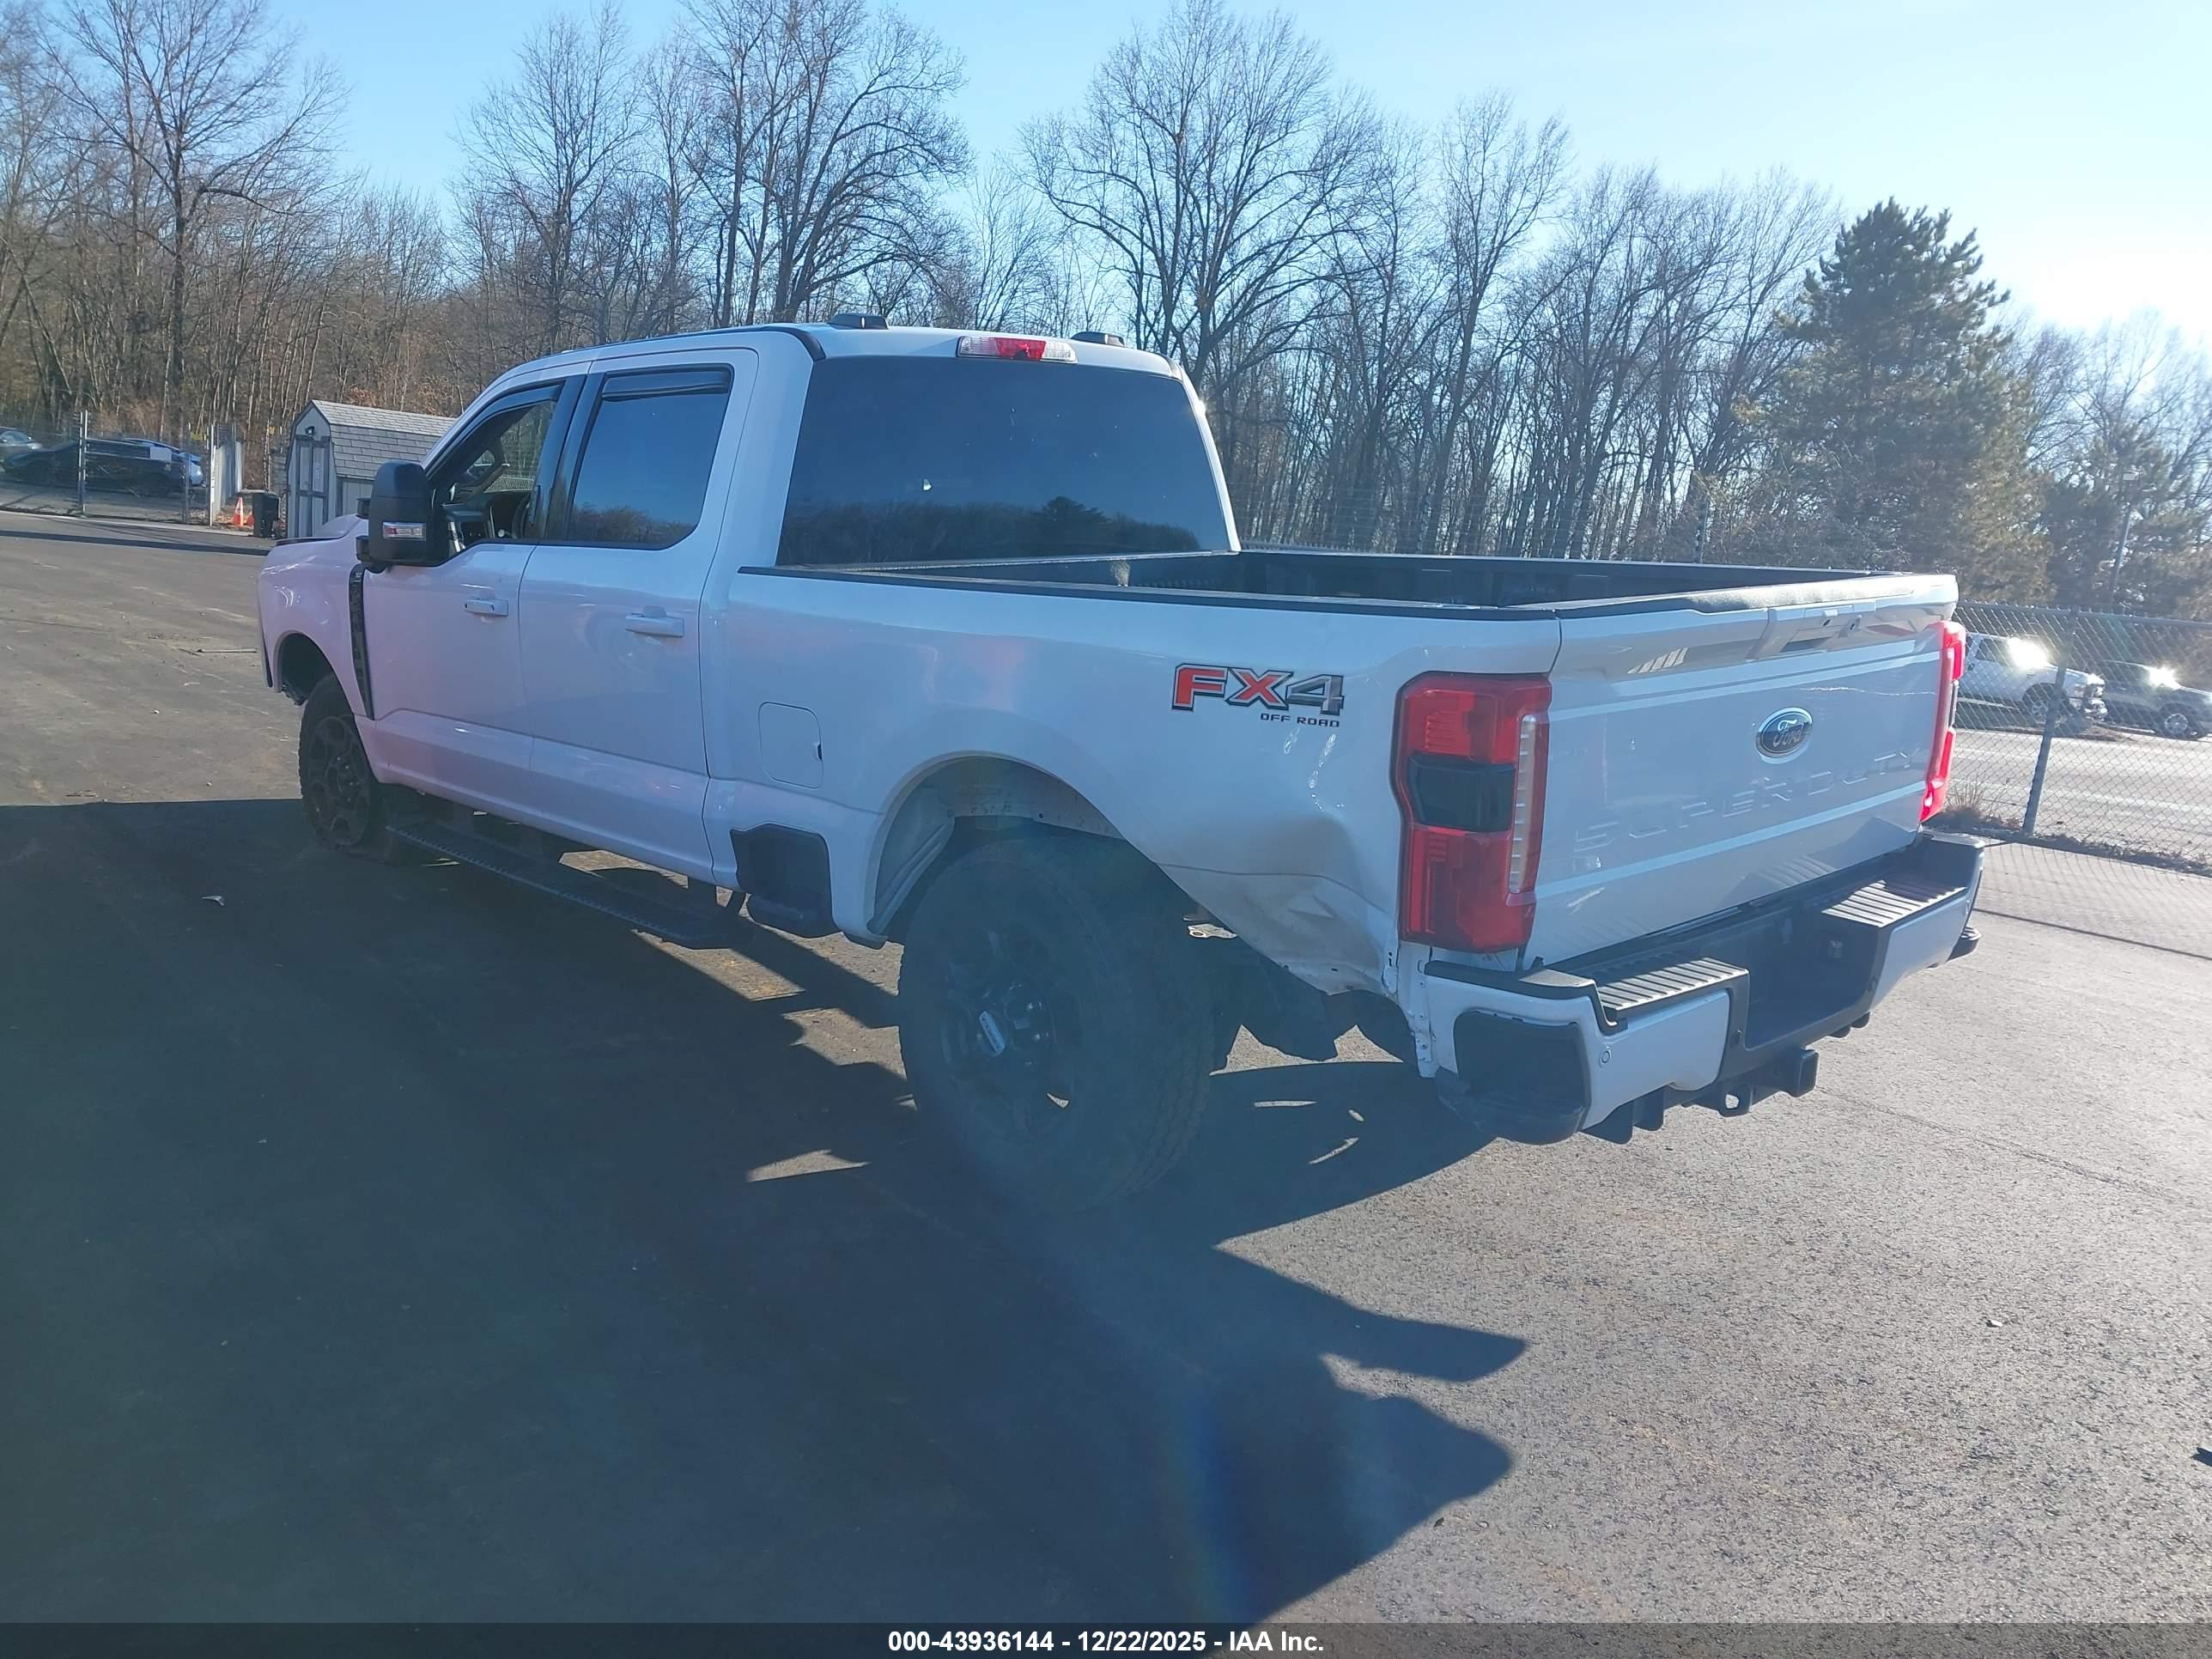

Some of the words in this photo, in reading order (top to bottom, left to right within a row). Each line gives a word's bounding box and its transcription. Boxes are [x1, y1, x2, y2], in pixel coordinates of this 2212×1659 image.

[1171, 663, 1345, 716] FX4
[1260, 713, 1291, 723] OFF
[1296, 715, 1340, 728] ROAD
[1772, 719, 1805, 747] Ford
[1573, 776, 1794, 852] SUPER
[1807, 744, 1922, 796] DUTY
